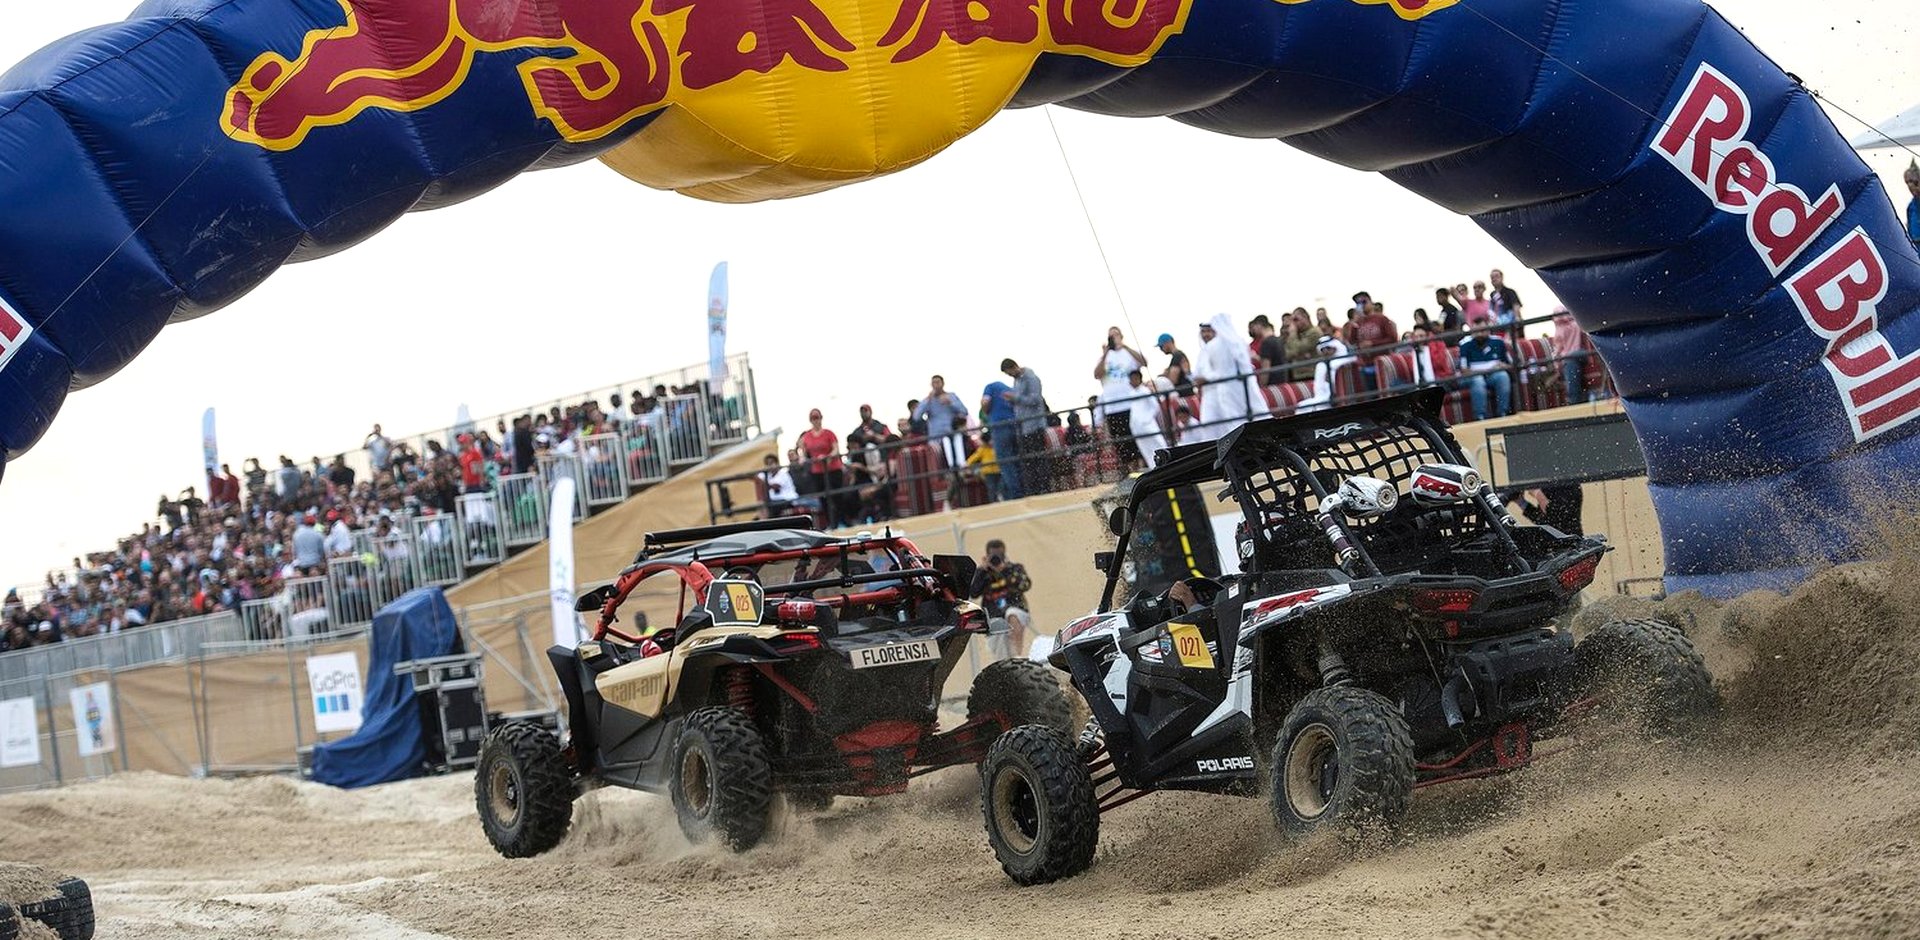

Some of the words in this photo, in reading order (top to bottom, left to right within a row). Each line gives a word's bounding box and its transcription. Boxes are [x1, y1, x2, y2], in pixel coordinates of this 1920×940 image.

[1656, 68, 1841, 269] Red
[1789, 232, 1920, 434] Bull
[1313, 422, 1363, 440] RZR
[735, 594, 750, 612] 025
[861, 642, 931, 666] FLORENSA
[1180, 636, 1201, 657] 021
[311, 669, 358, 693] GoPro
[610, 674, 664, 703] can-am
[1196, 756, 1254, 773] POLARIS
